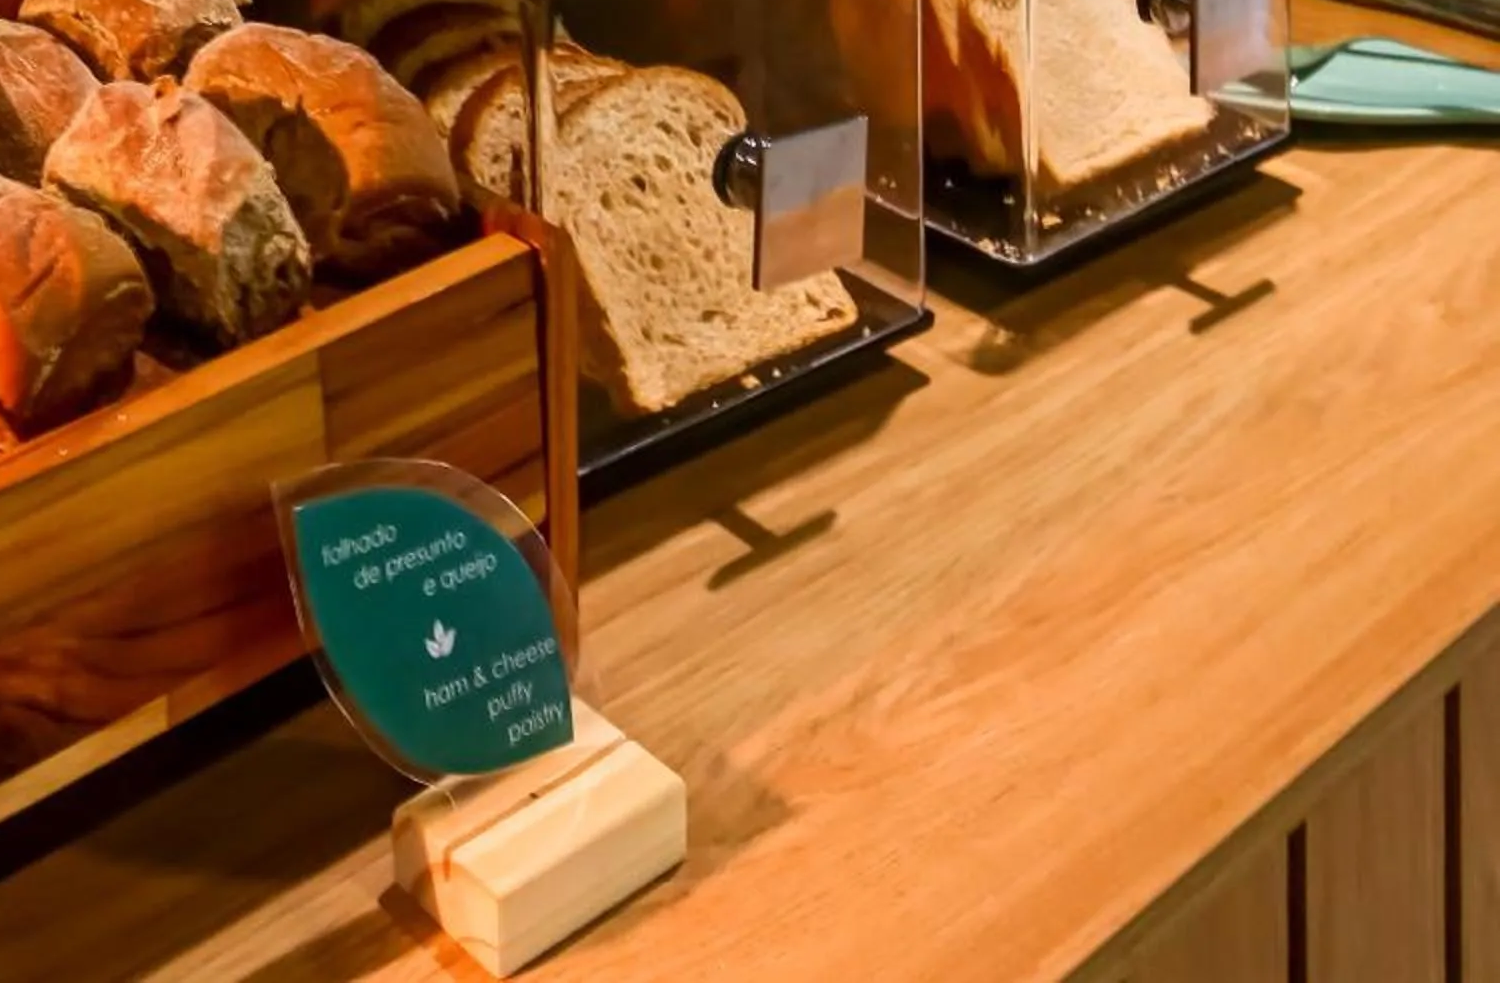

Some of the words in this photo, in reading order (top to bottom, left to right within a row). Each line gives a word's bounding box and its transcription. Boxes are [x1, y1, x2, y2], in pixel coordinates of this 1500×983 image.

[321, 523, 397, 567] folhado
[354, 563, 381, 589] de
[385, 530, 466, 580] presunto
[423, 577, 436, 596] e
[441, 551, 498, 589] queijo
[424, 677, 469, 709] ham
[473, 665, 488, 687] &
[492, 636, 557, 679] cheese
[487, 680, 533, 721] puffy
